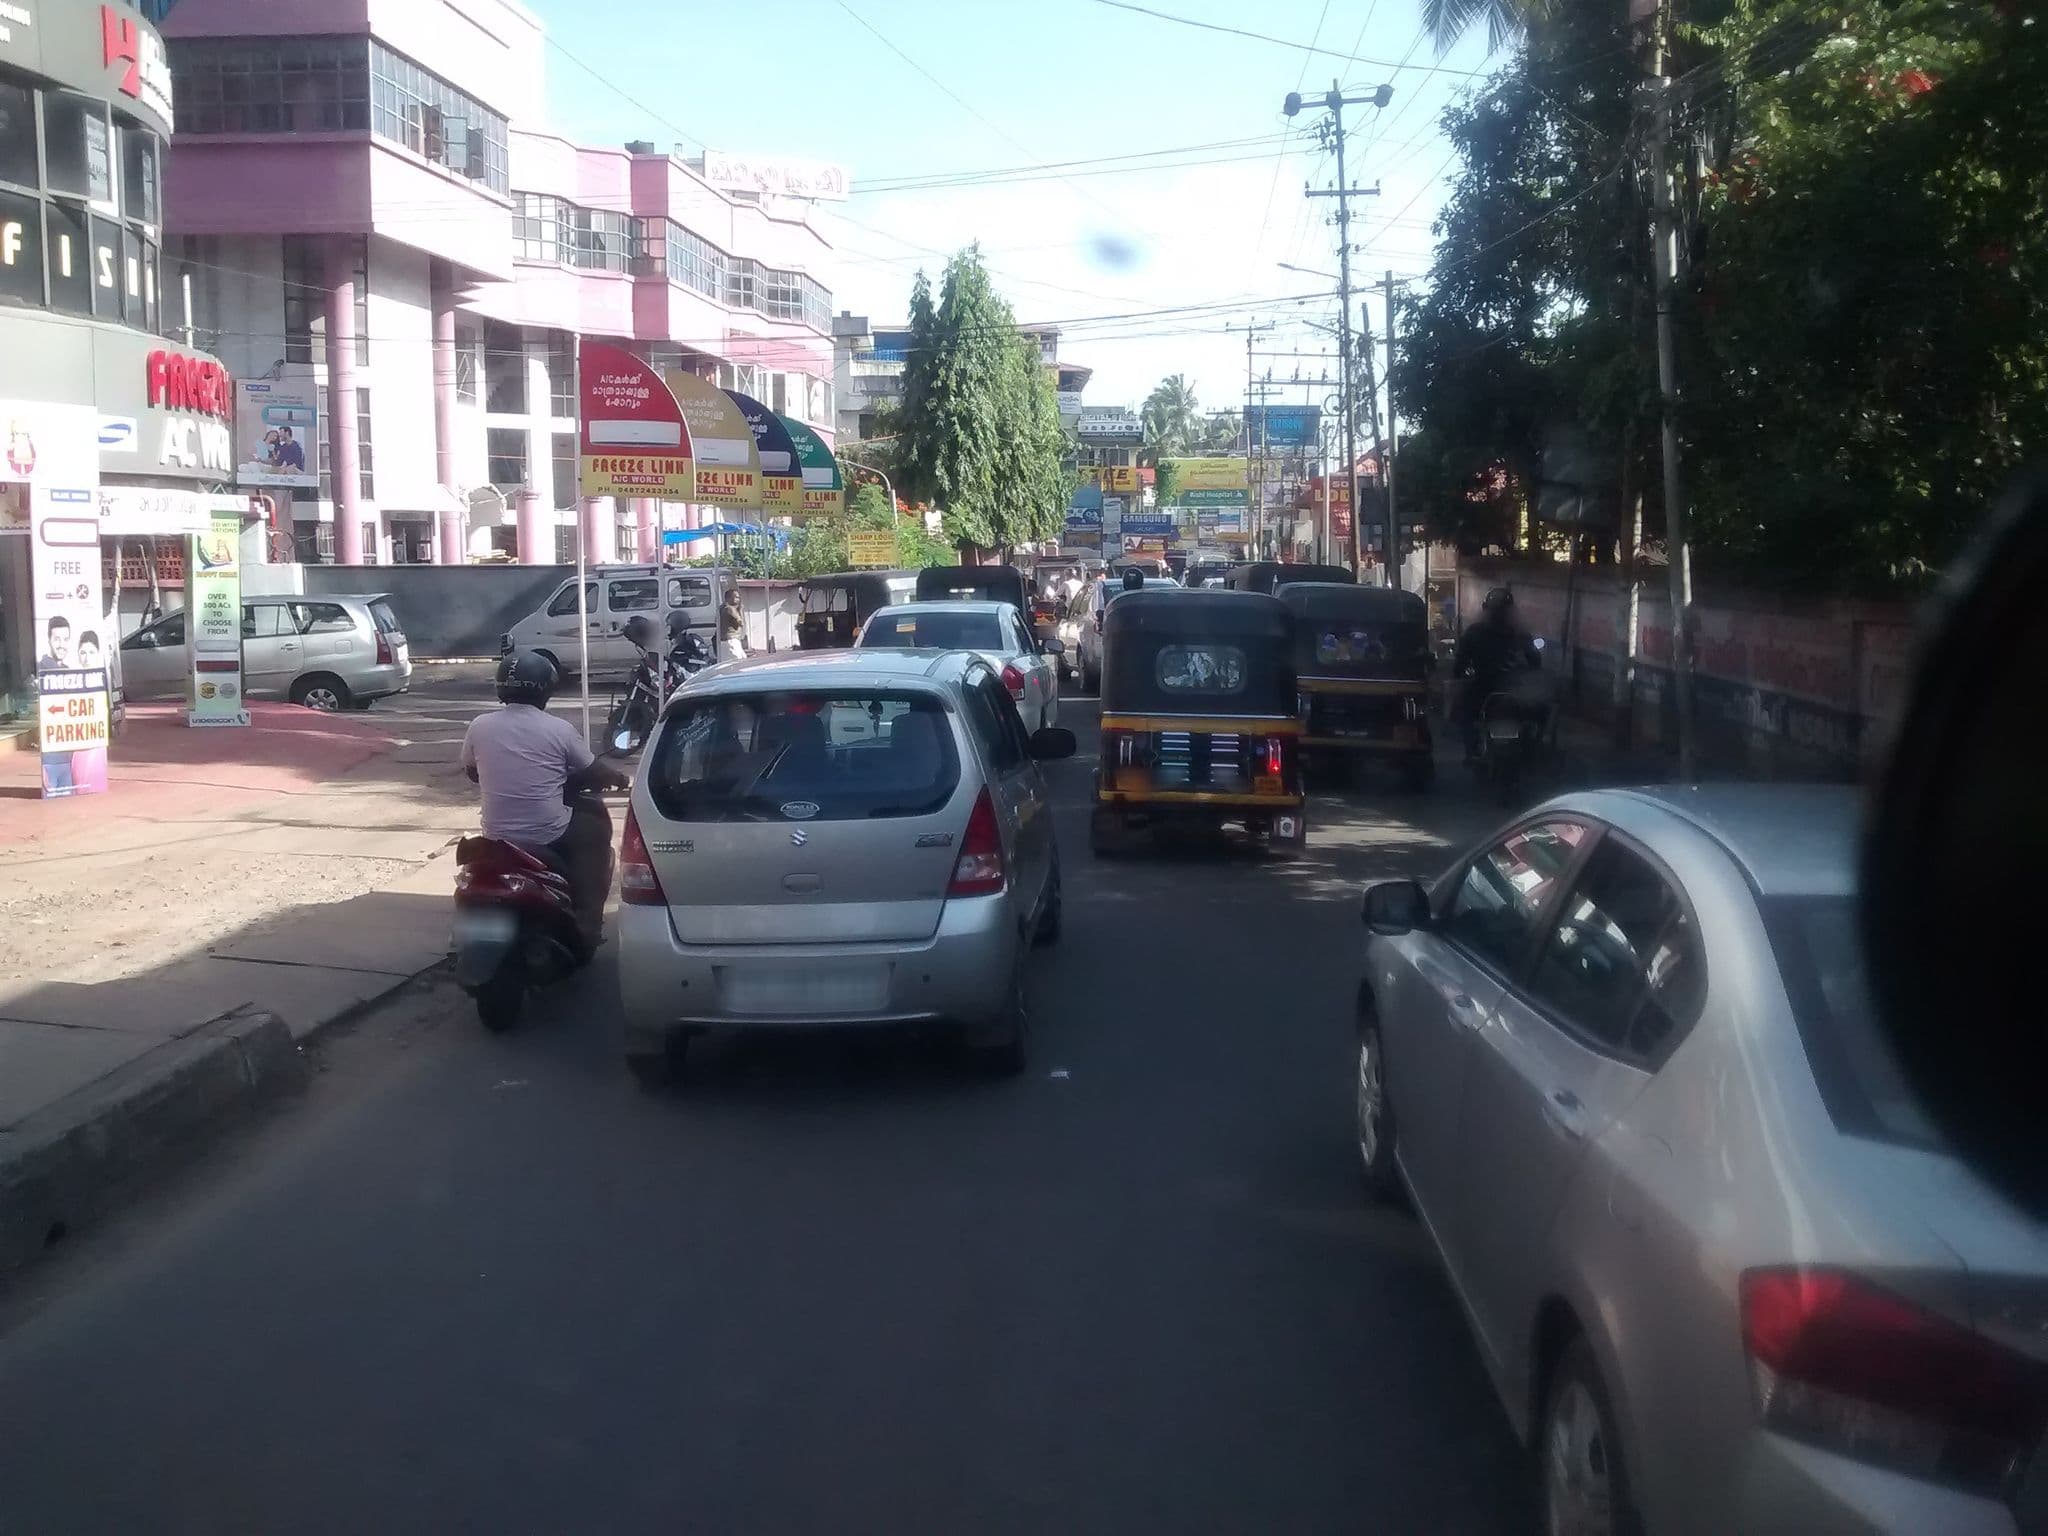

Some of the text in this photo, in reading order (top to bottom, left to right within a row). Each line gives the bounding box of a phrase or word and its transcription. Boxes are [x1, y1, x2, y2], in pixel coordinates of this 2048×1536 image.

[160, 416, 197, 468] AC
[592, 458, 685, 475] FREEZE LINK
[631, 475, 665, 485] WORLD
[723, 472, 753, 487] LINK
[706, 486, 736, 494] WORLD
[1122, 515, 1168, 523] SAMSUNG
[54, 561, 81, 575] FREE
[67, 698, 95, 718] CAR
[46, 721, 104, 743] PARKING
